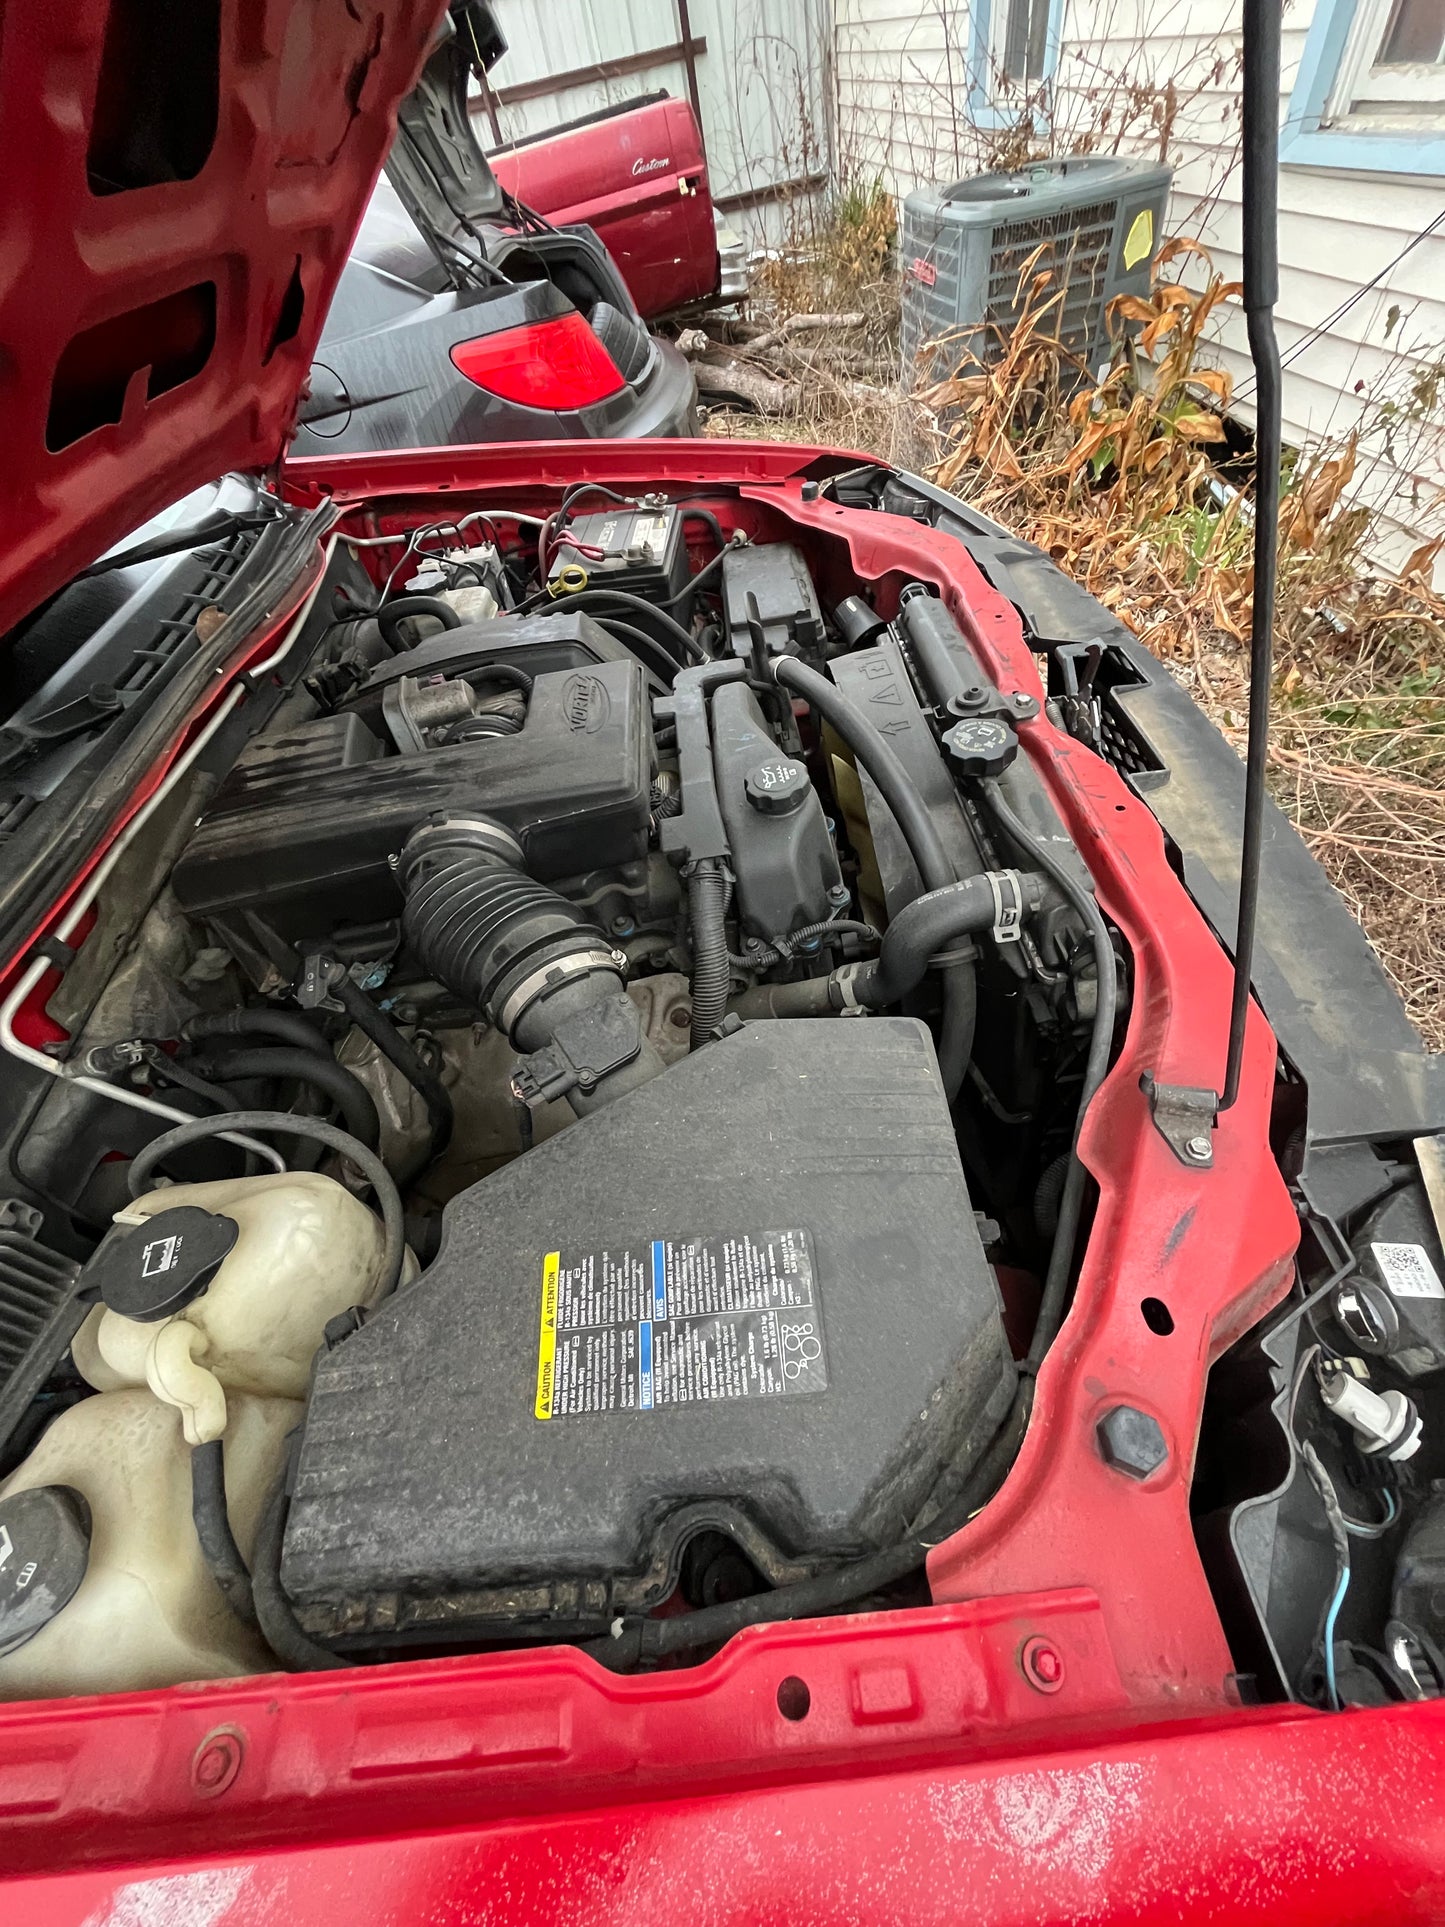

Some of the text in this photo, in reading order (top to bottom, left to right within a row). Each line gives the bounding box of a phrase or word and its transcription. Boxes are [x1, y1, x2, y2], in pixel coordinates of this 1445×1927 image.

[632, 157, 669, 176] Custom
[700, 1340, 708, 1386] CONDITIONING
[542, 1362, 551, 1399] CAUTION
[642, 1372, 651, 1404] NOTICE
